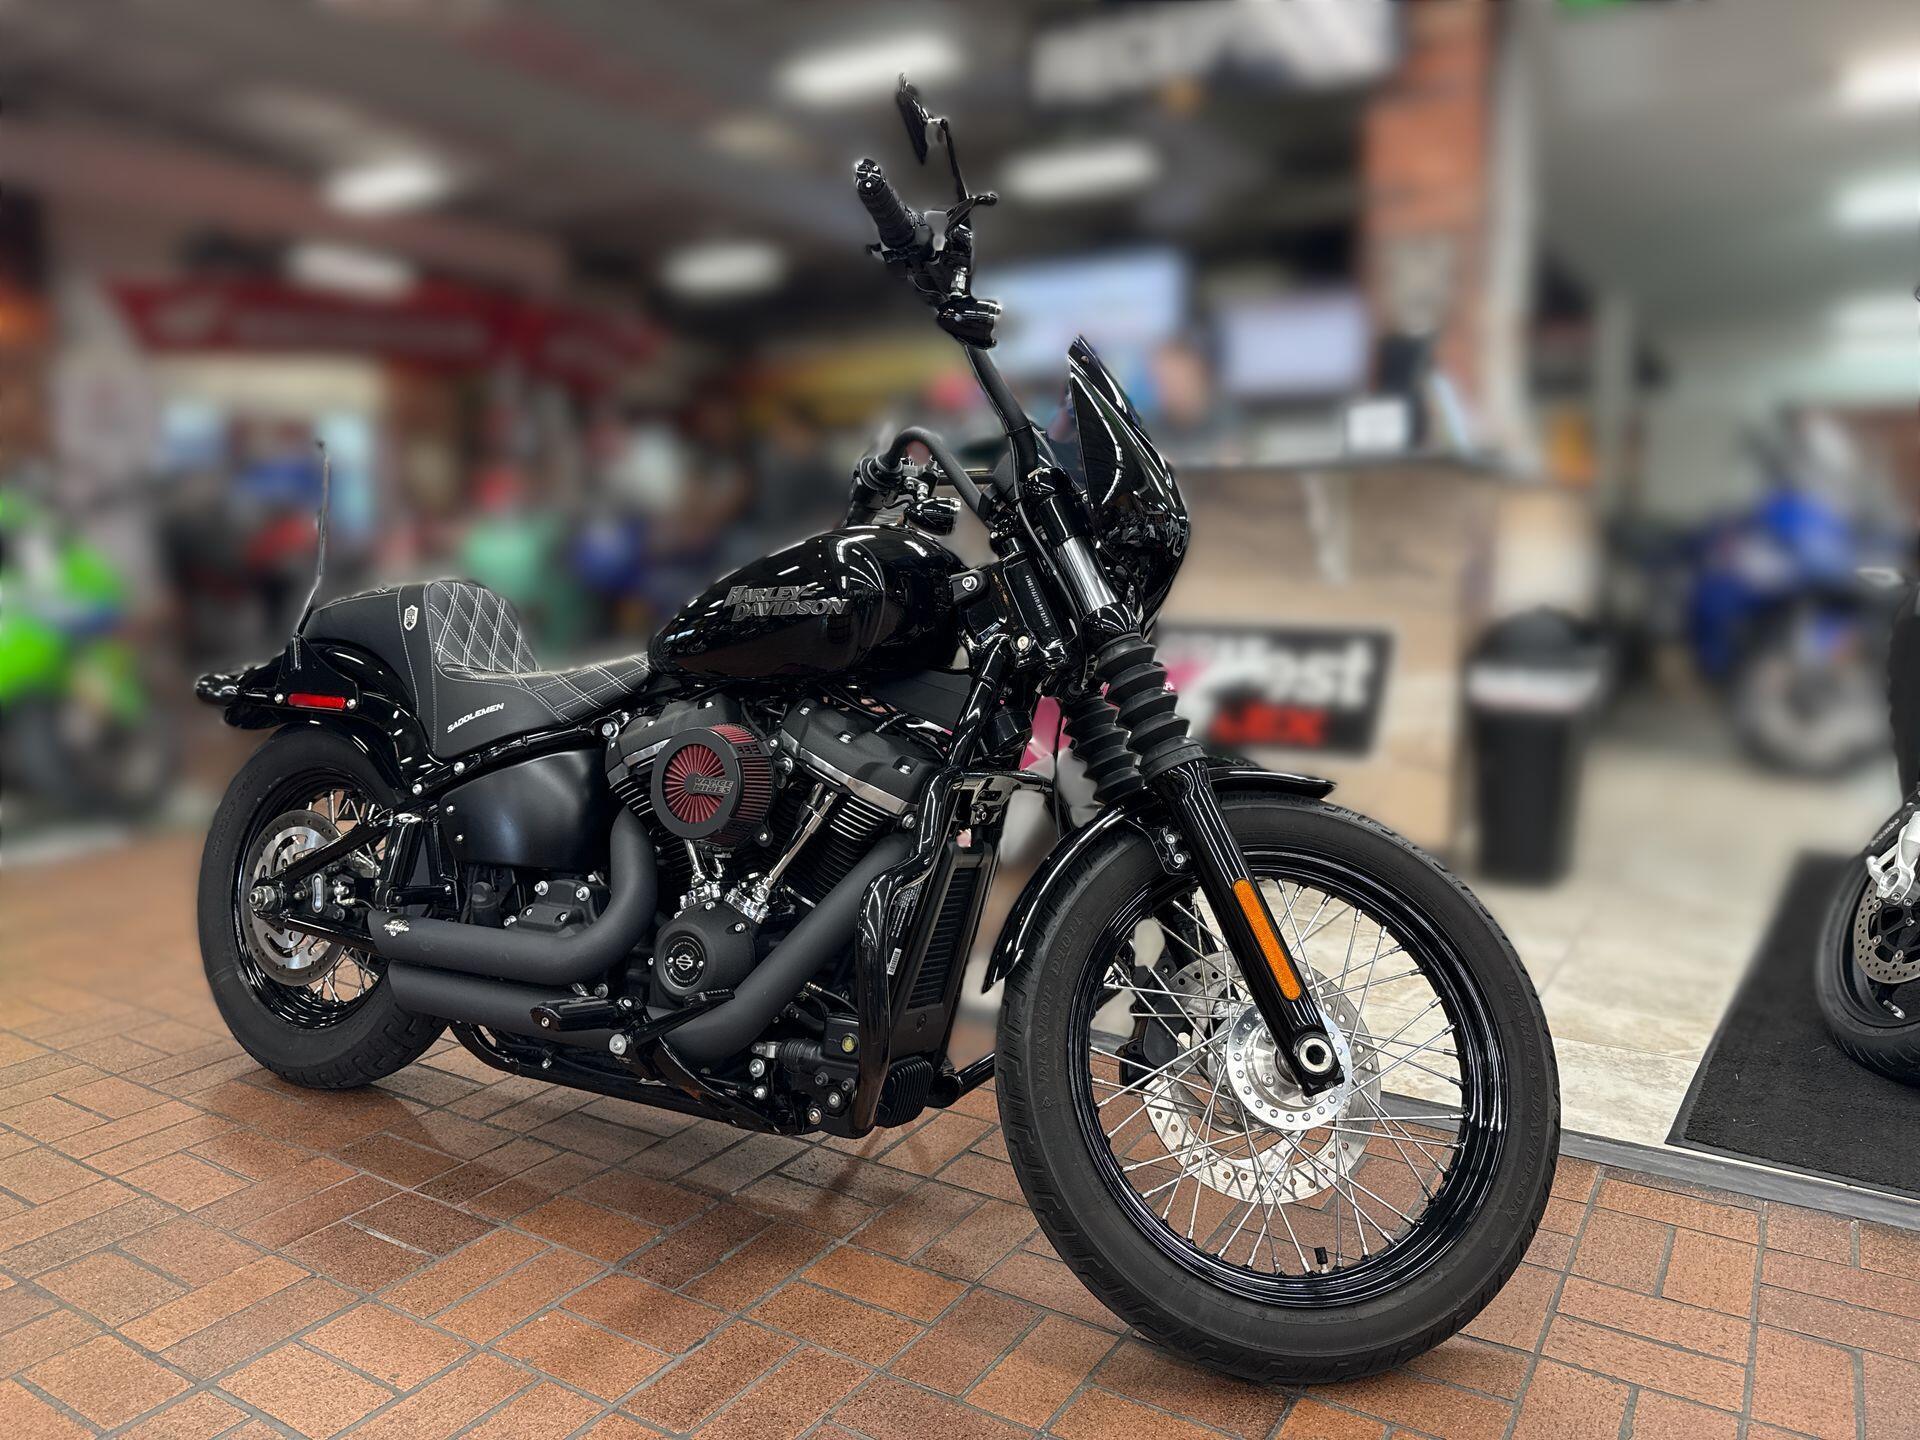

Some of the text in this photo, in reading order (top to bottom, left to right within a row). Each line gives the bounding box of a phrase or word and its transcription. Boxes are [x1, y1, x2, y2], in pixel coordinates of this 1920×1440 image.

[731, 597, 849, 621] DAVIDSON
[447, 702, 505, 733] SADDLEMEN
[693, 784, 731, 795] HINES
[694, 777, 734, 788] VANCE
